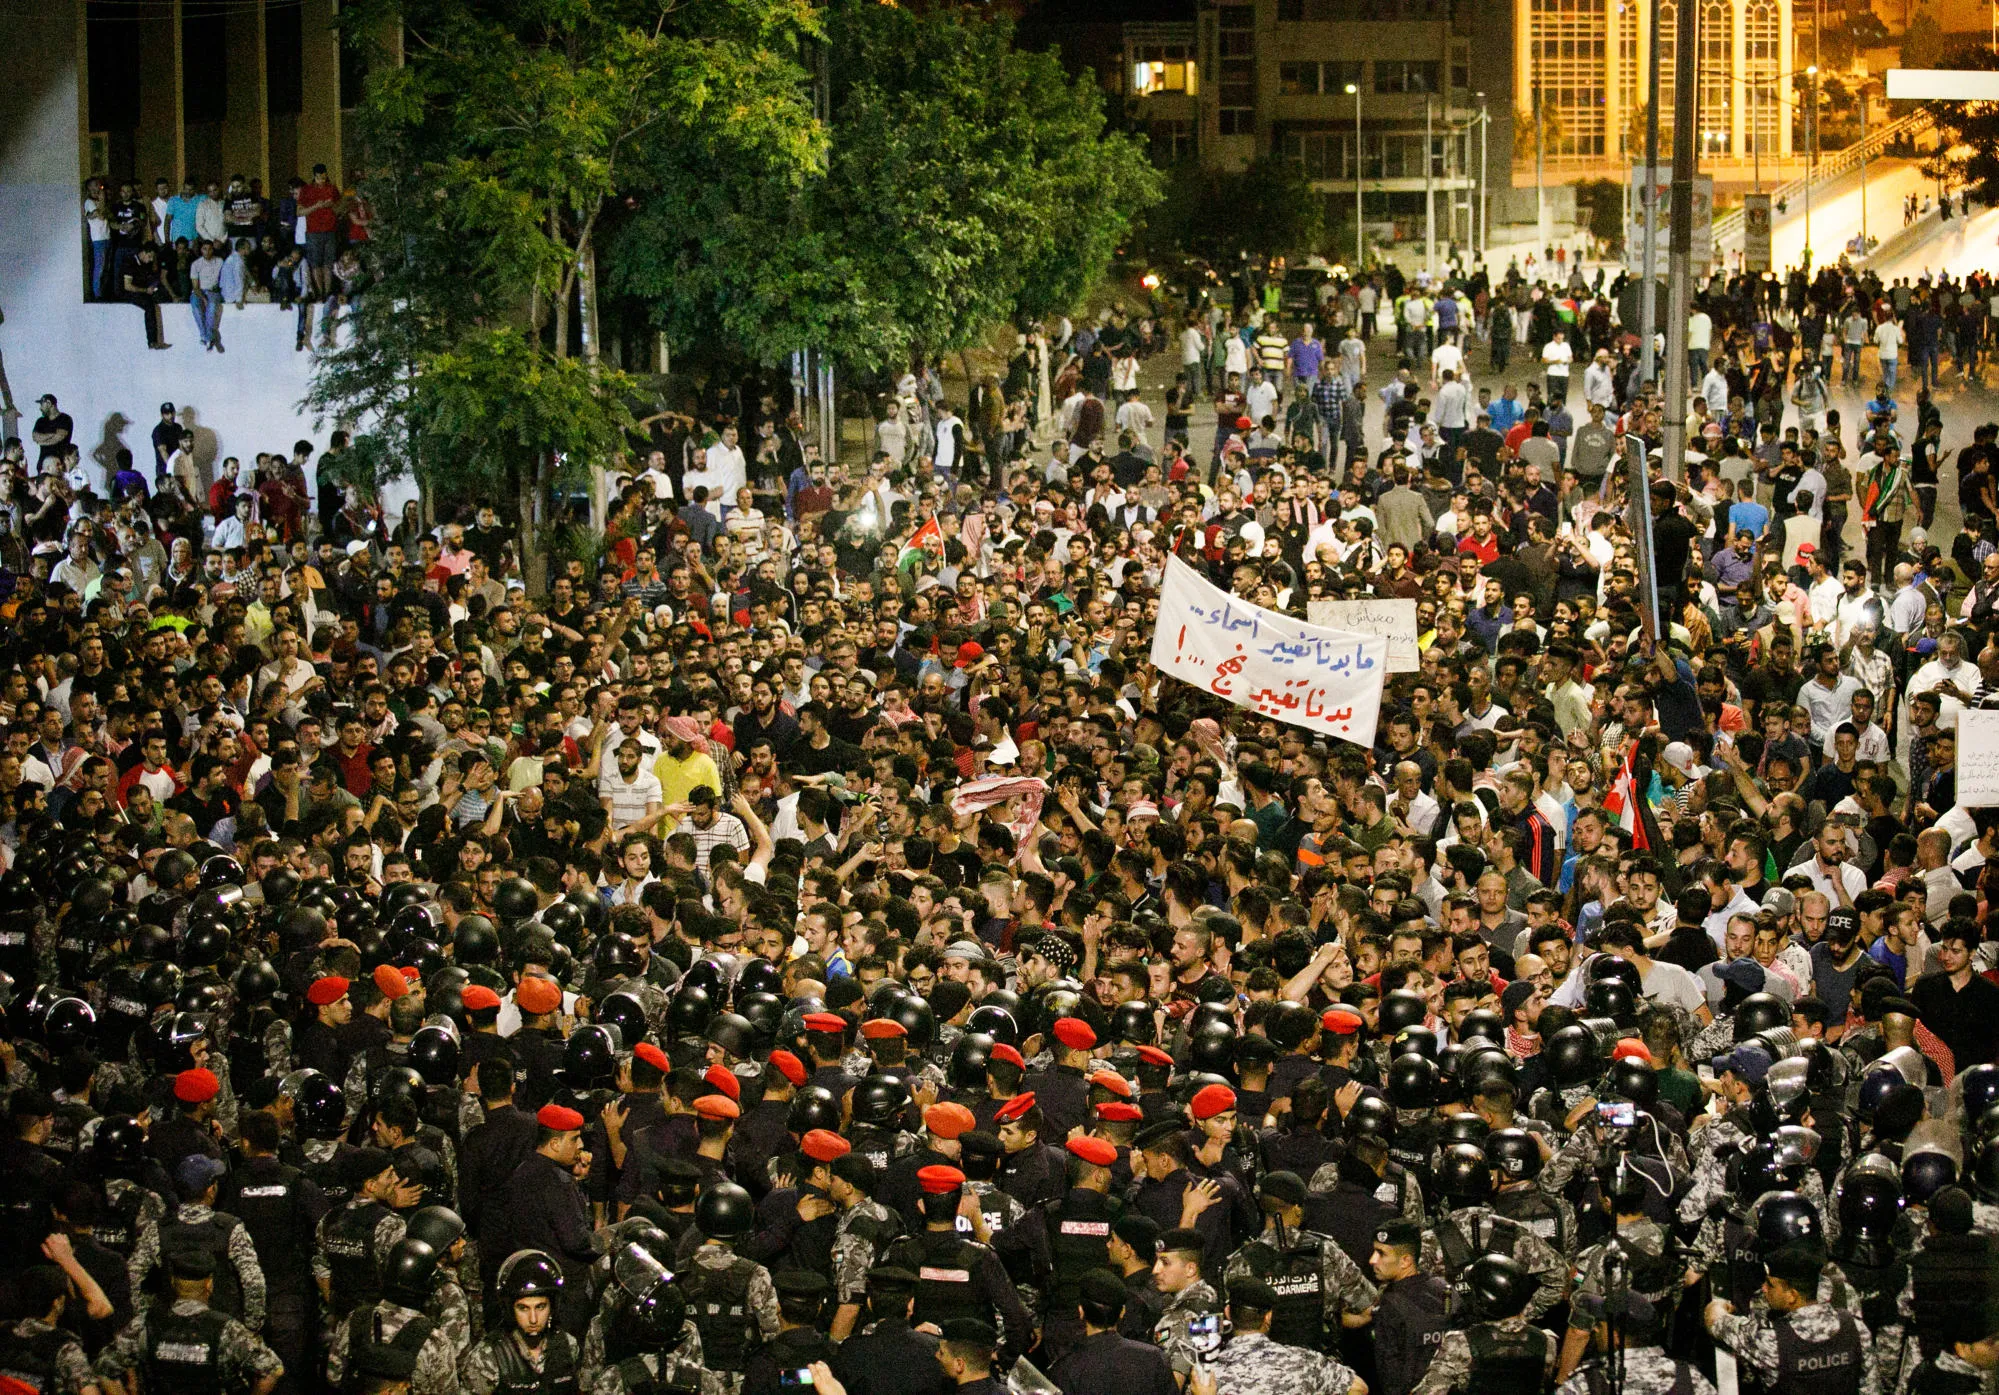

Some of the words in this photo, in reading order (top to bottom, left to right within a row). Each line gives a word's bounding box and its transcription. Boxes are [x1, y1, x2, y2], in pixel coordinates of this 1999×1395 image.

[1317, 640, 1351, 678] بدنا
[1356, 643, 1374, 669] ما
[1249, 679, 1310, 715] تغيير
[1306, 688, 1353, 733] بدنا
[1382, 763, 1393, 775] 3
[1828, 915, 1853, 929] DOPE
[1797, 1351, 1849, 1372] POLICE
